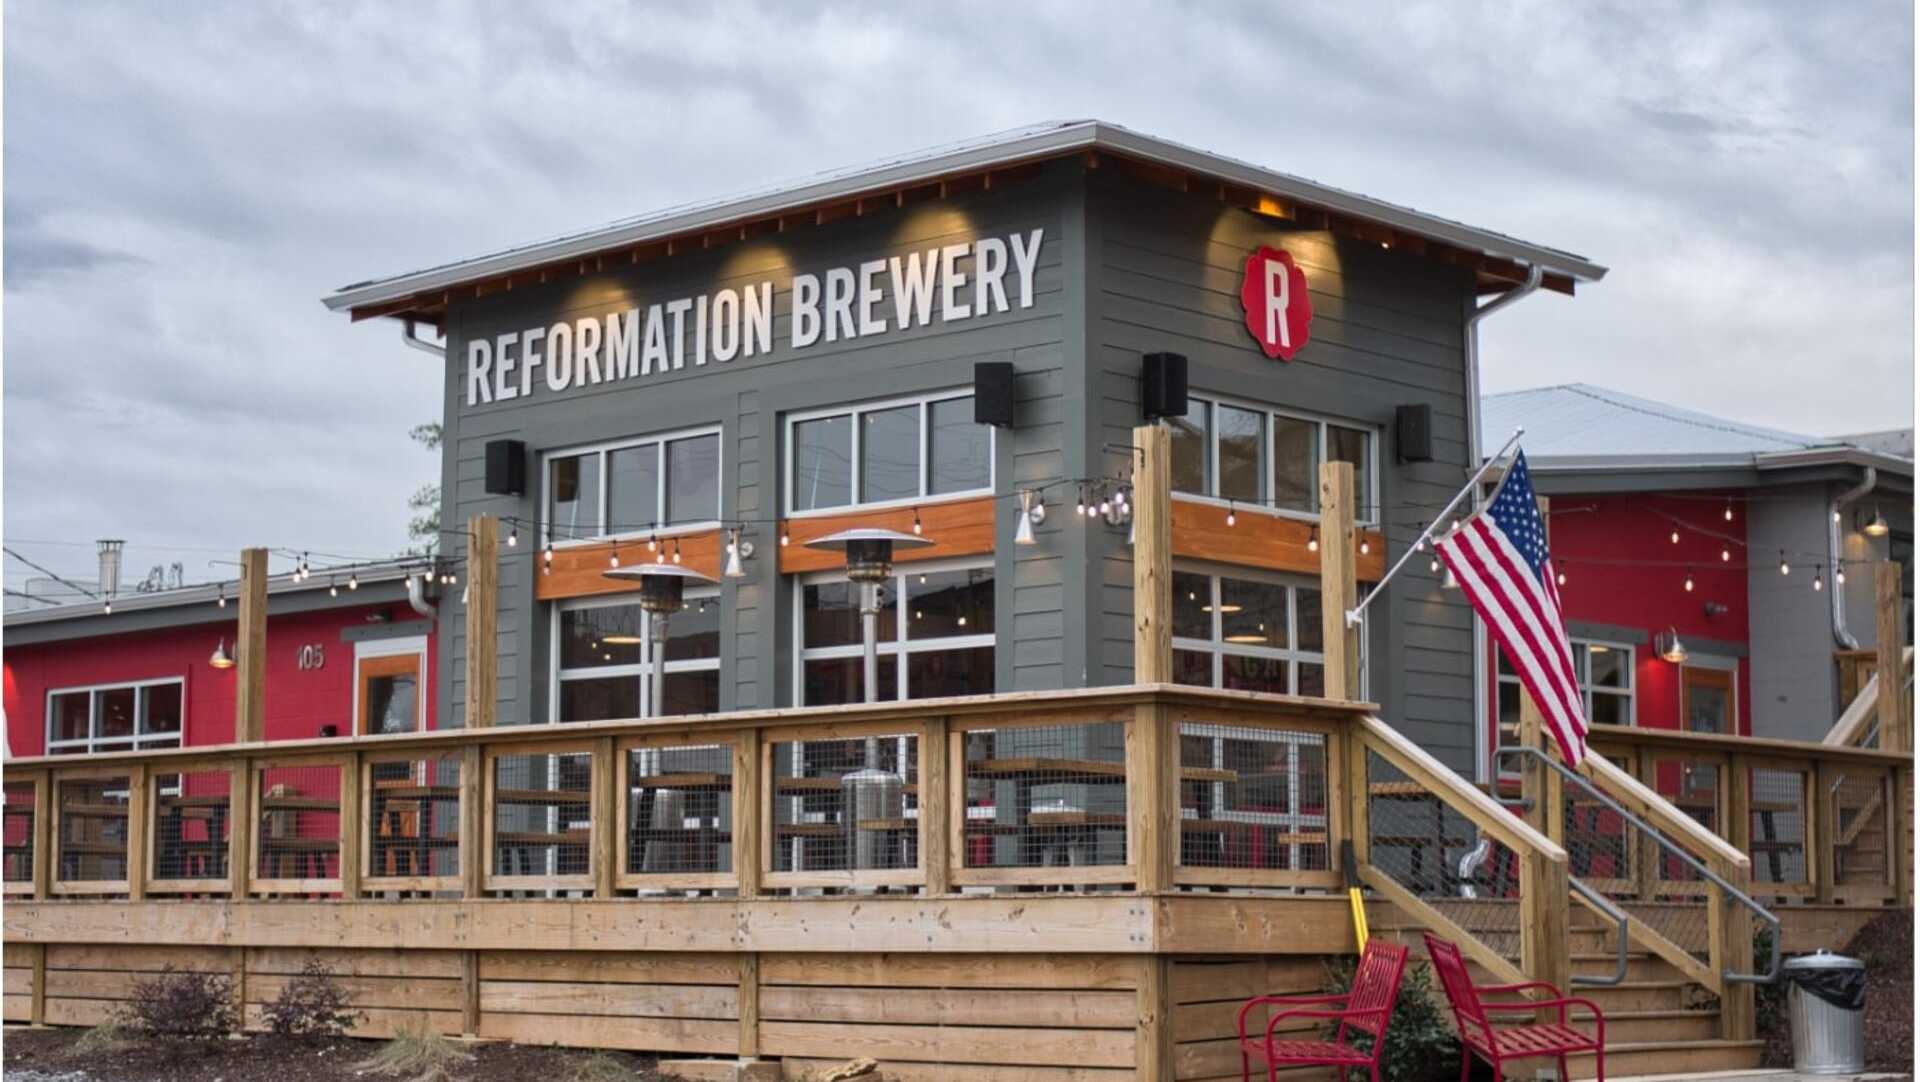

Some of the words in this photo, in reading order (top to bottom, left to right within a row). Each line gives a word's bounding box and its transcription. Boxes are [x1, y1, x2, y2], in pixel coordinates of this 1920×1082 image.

[467, 281, 774, 406] REFORMATION
[791, 229, 1044, 349] BREWERY
[1265, 259, 1291, 348] R
[297, 643, 324, 670] 105
